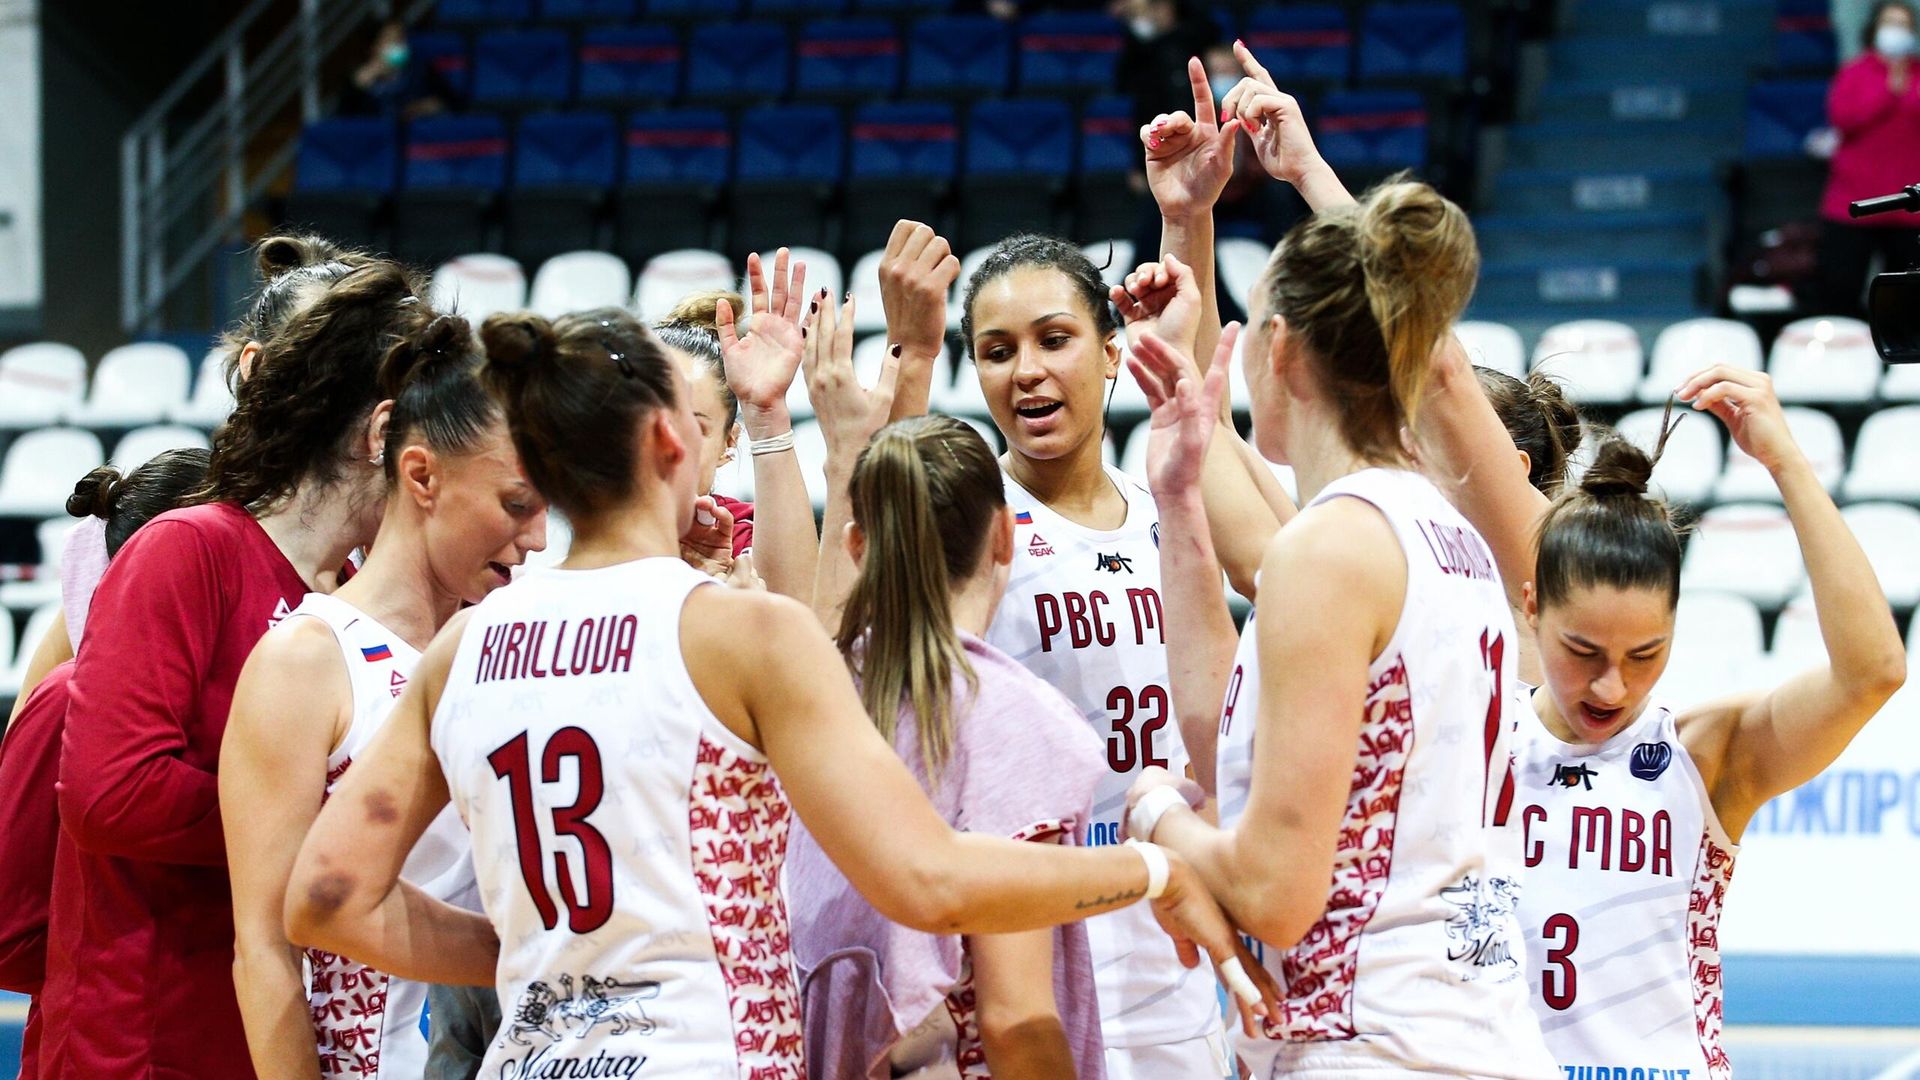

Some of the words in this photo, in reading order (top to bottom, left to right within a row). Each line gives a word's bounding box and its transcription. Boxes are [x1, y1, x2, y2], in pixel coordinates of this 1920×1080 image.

[1028, 546, 1055, 557] PEAK
[476, 614, 638, 684] KIRILLOVA
[1034, 590, 1116, 653] PBC
[1106, 685, 1168, 774] 32
[486, 726, 615, 934] 13
[1569, 806, 1673, 877] MBA
[1542, 913, 1579, 1011] 3
